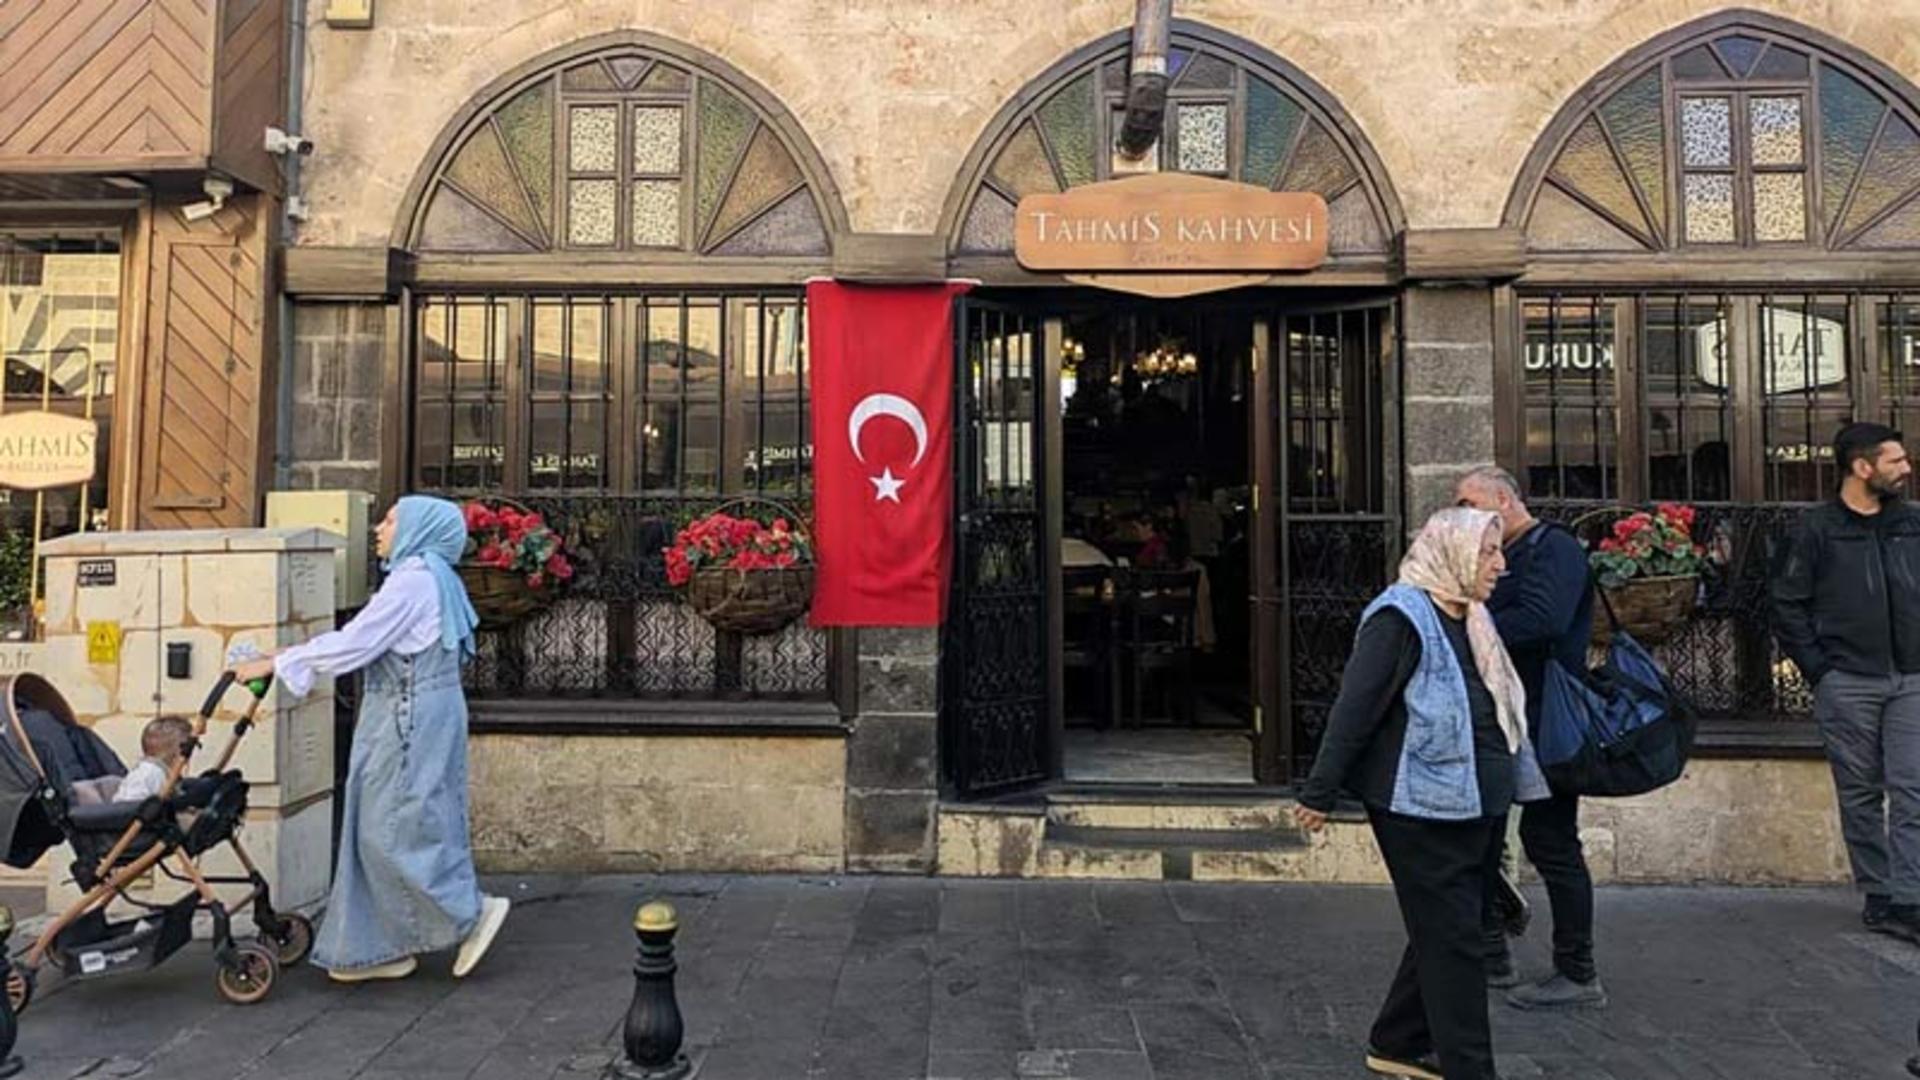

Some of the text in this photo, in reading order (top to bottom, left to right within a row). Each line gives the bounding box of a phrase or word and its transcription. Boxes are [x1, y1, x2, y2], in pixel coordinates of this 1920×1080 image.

[1177, 212, 1312, 241] KAHVESİ
[0, 431, 90, 457] AHMİS
[0, 648, 32, 668] .tr
